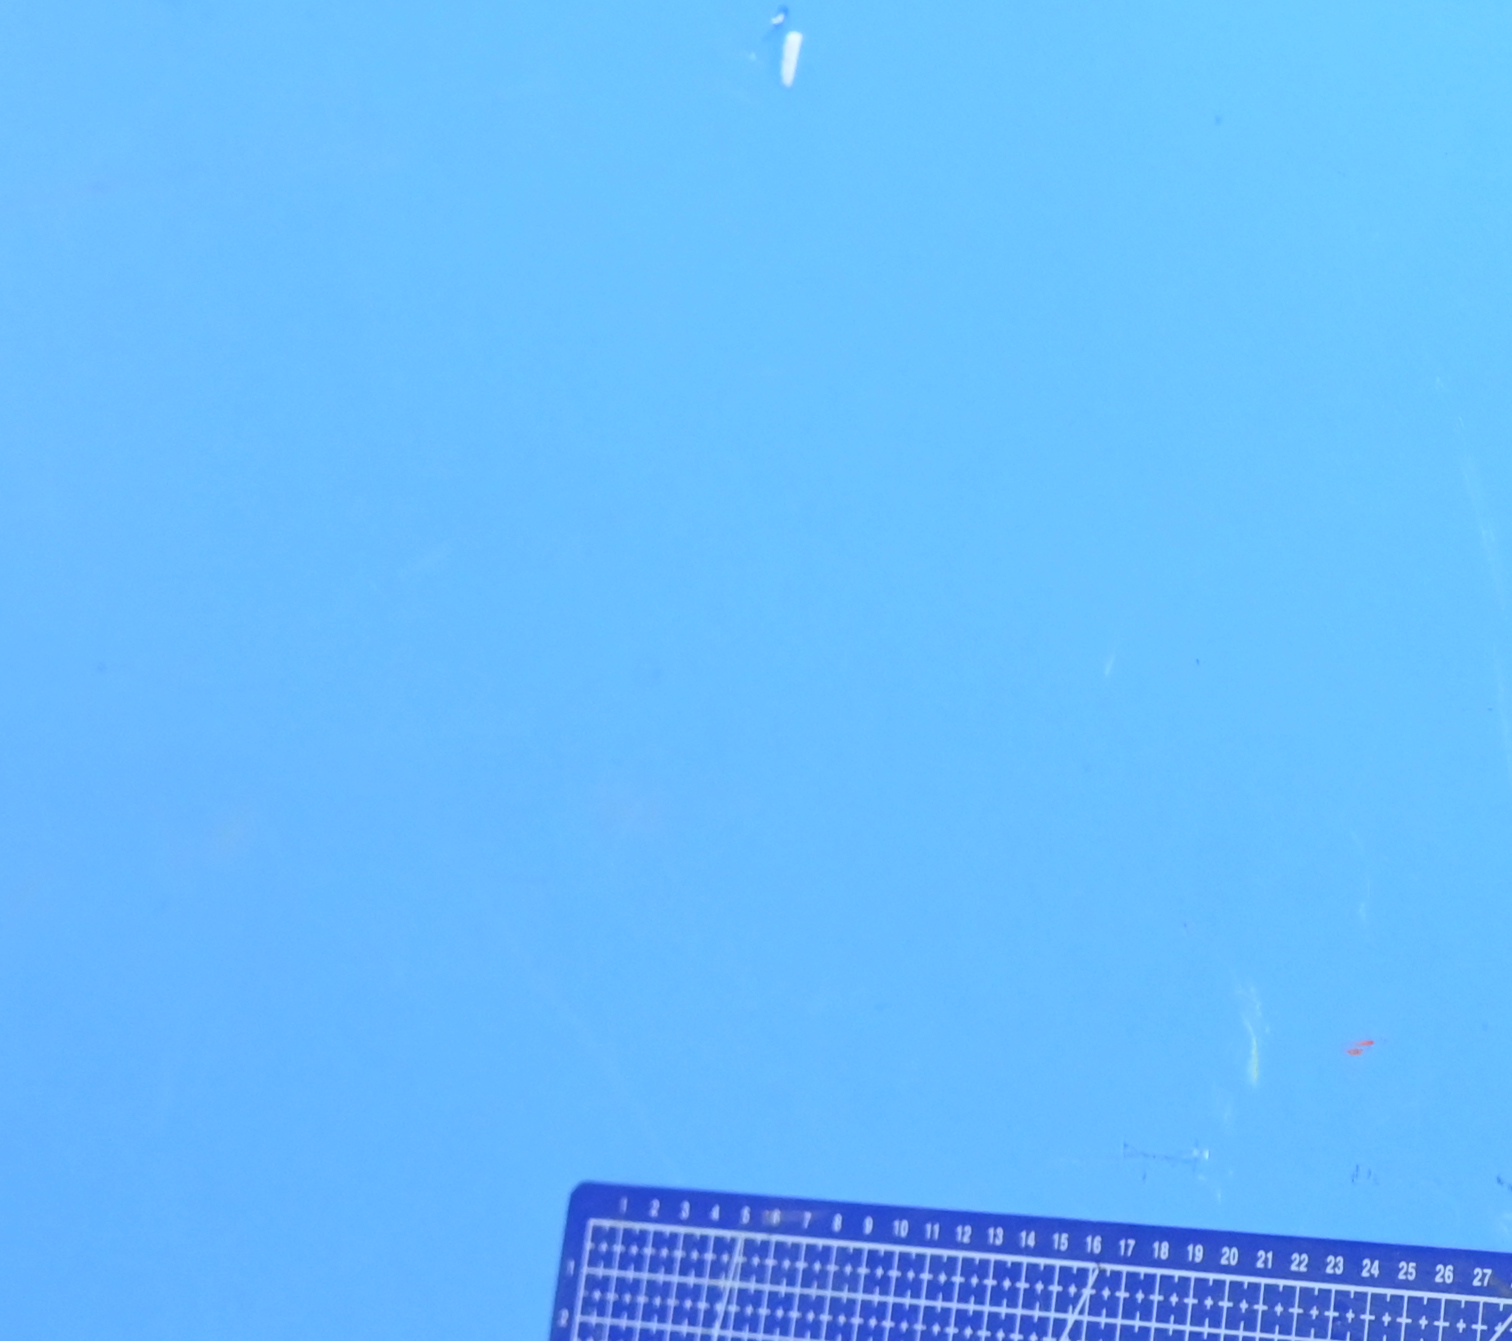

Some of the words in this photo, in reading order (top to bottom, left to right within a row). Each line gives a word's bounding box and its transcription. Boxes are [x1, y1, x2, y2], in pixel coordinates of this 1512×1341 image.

[648, 1198, 661, 1219] 2
[831, 1212, 844, 1234] 8
[862, 1215, 875, 1236] 9
[892, 1218, 910, 1239] 10
[924, 1221, 941, 1242] 11
[955, 1223, 973, 1245] 12
[987, 1225, 1005, 1247] 13
[1018, 1229, 1037, 1249] 14
[1051, 1231, 1070, 1253] 15
[1085, 1234, 1103, 1256] 16
[1118, 1237, 1137, 1258] 17
[1151, 1239, 1171, 1261] 18
[1186, 1242, 1205, 1264] 19
[1219, 1245, 1240, 1267] 20
[1254, 1248, 1274, 1270] 21
[1289, 1251, 1310, 1274] 22
[1324, 1253, 1345, 1276] 23
[1360, 1257, 1381, 1279] 24
[1396, 1260, 1418, 1282] 25
[1433, 1262, 1455, 1285] 26
[1471, 1266, 1494, 1288] 27
